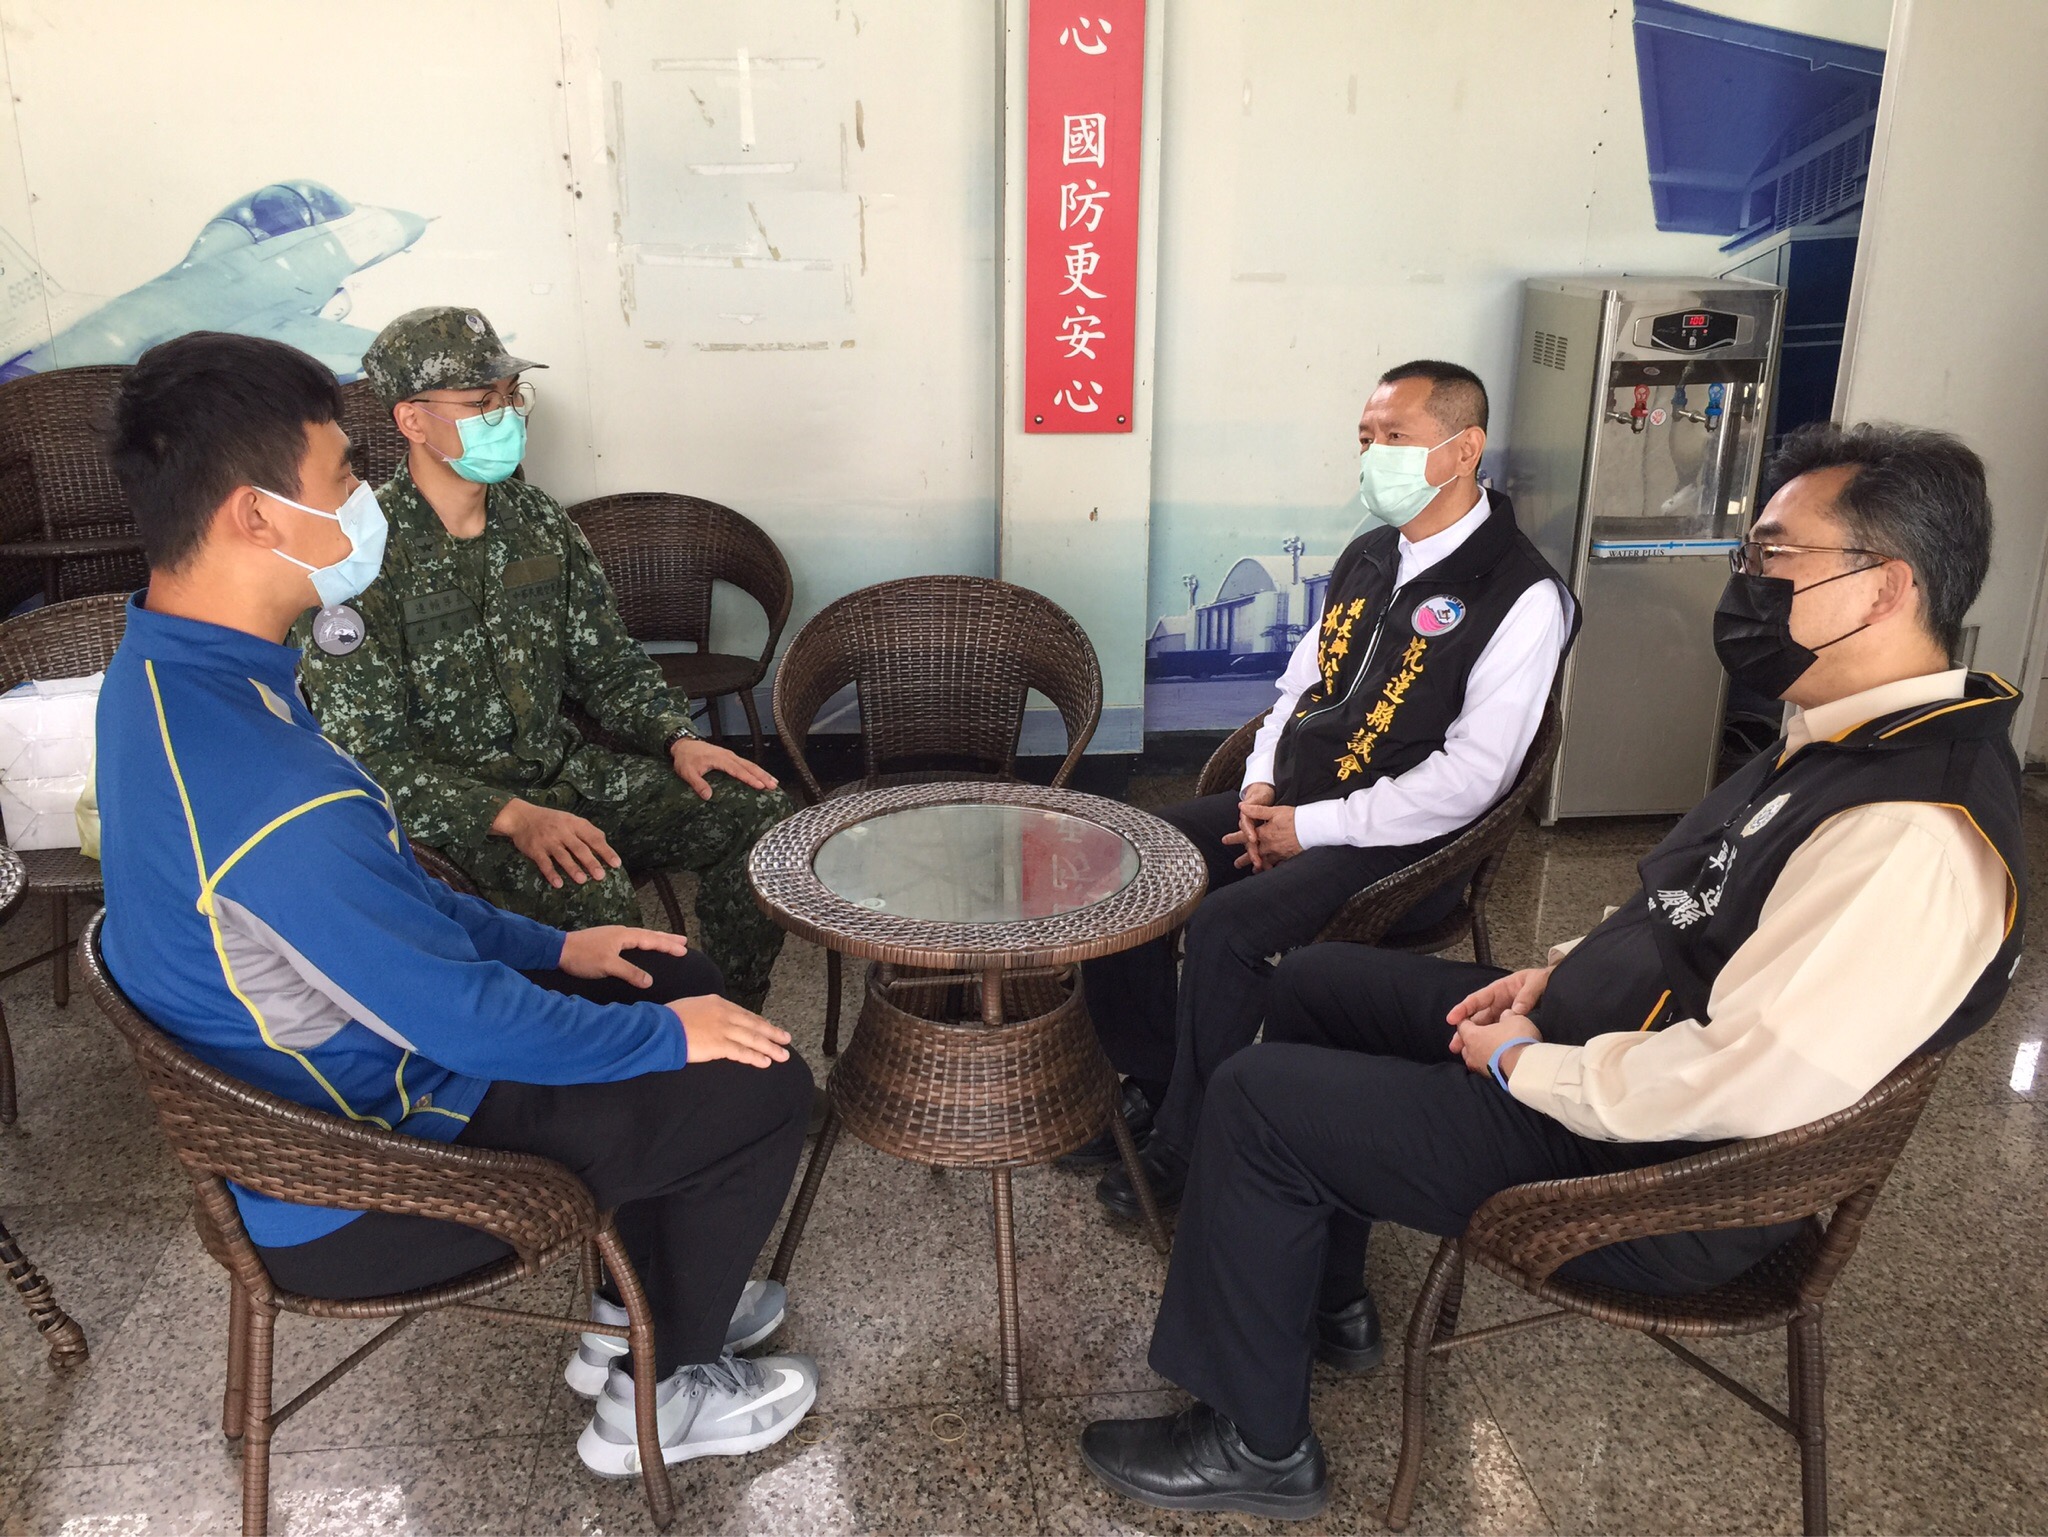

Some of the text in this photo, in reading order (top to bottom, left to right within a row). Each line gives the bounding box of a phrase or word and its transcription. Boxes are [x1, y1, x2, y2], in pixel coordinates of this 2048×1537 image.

[1053, 15, 1113, 413] 心 國防更安心
[1689, 316, 1705, 326] 100
[1642, 549, 1665, 557] PLUS
[1334, 635, 1427, 781] 花蓮縣議會
